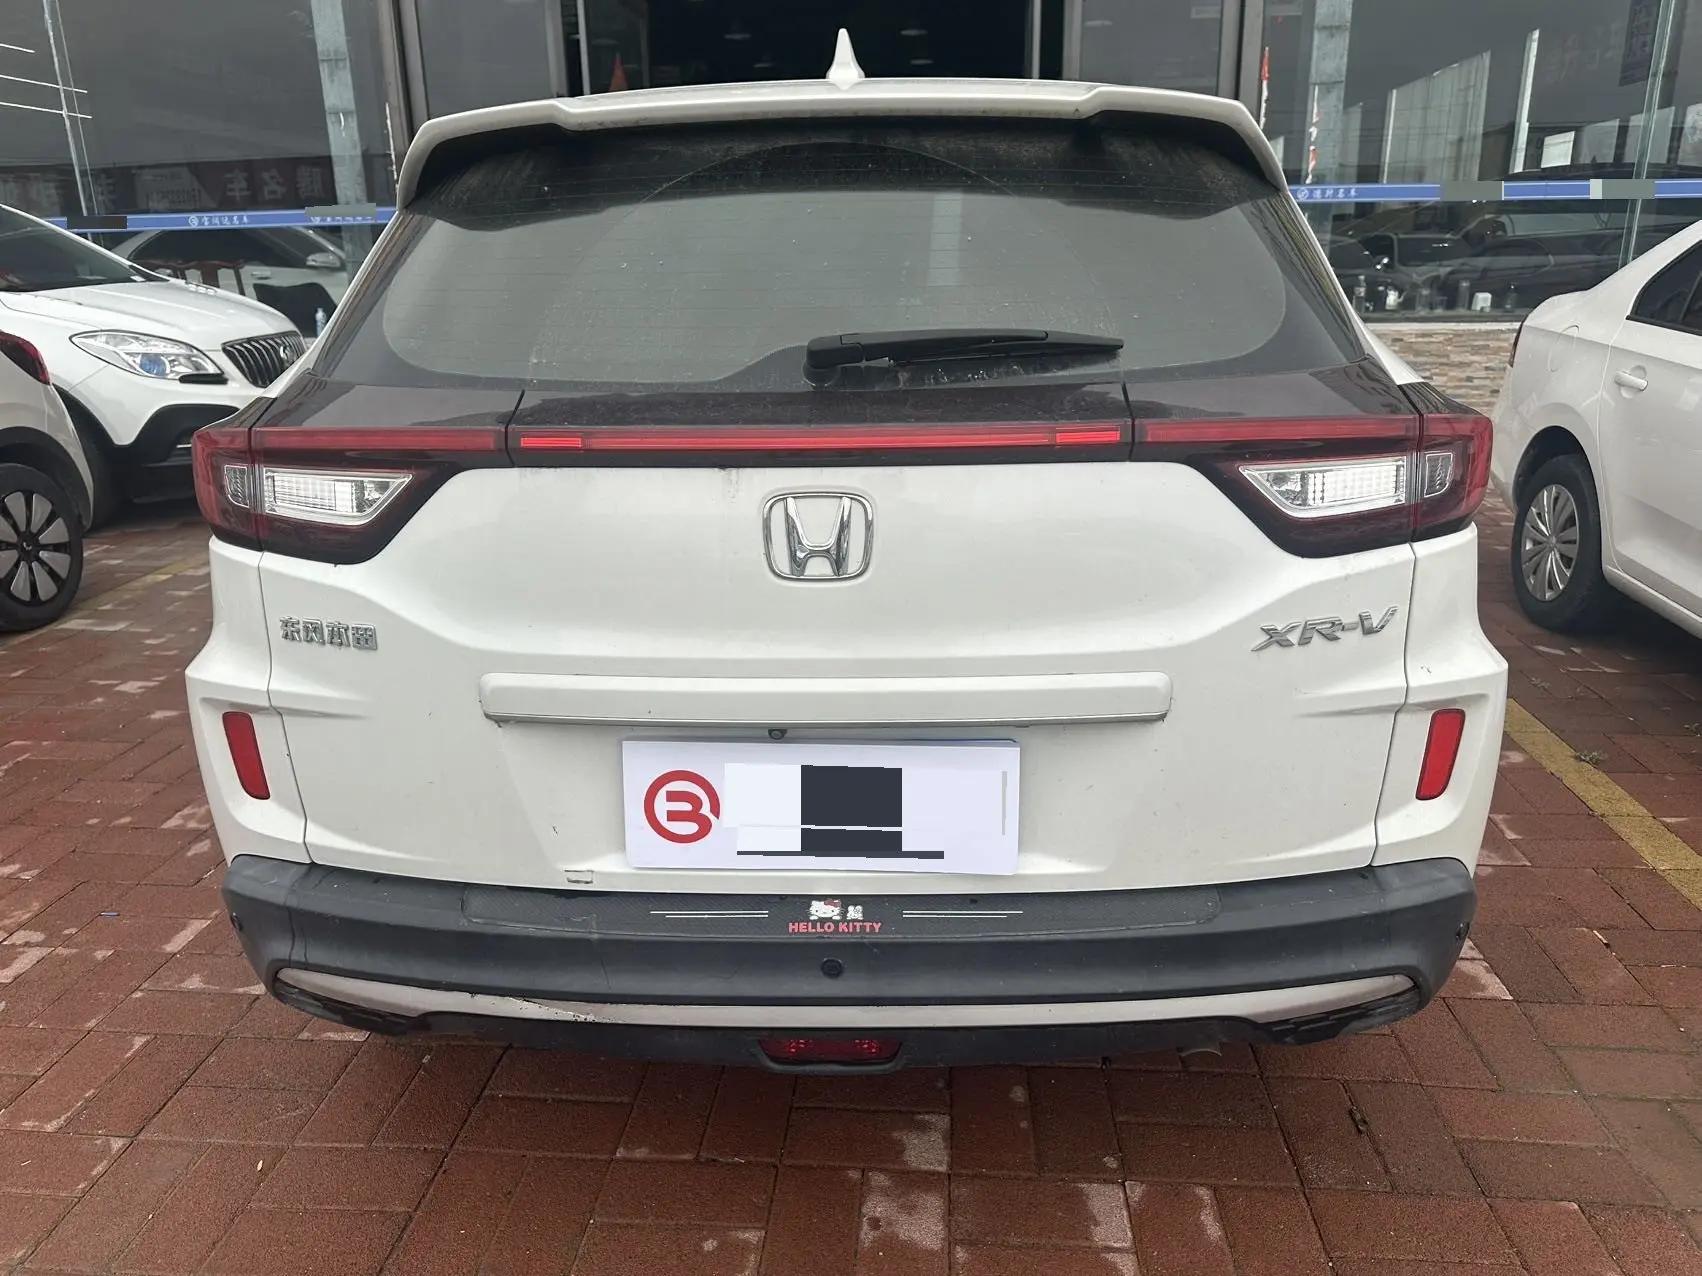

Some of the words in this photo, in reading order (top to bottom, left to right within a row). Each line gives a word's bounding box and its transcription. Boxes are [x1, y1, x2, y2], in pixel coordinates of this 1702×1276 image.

[280, 616, 378, 650] 东风本田
[1251, 606, 1398, 651] XR-V
[788, 922, 835, 933] HELLO
[838, 921, 882, 933] KITTY
